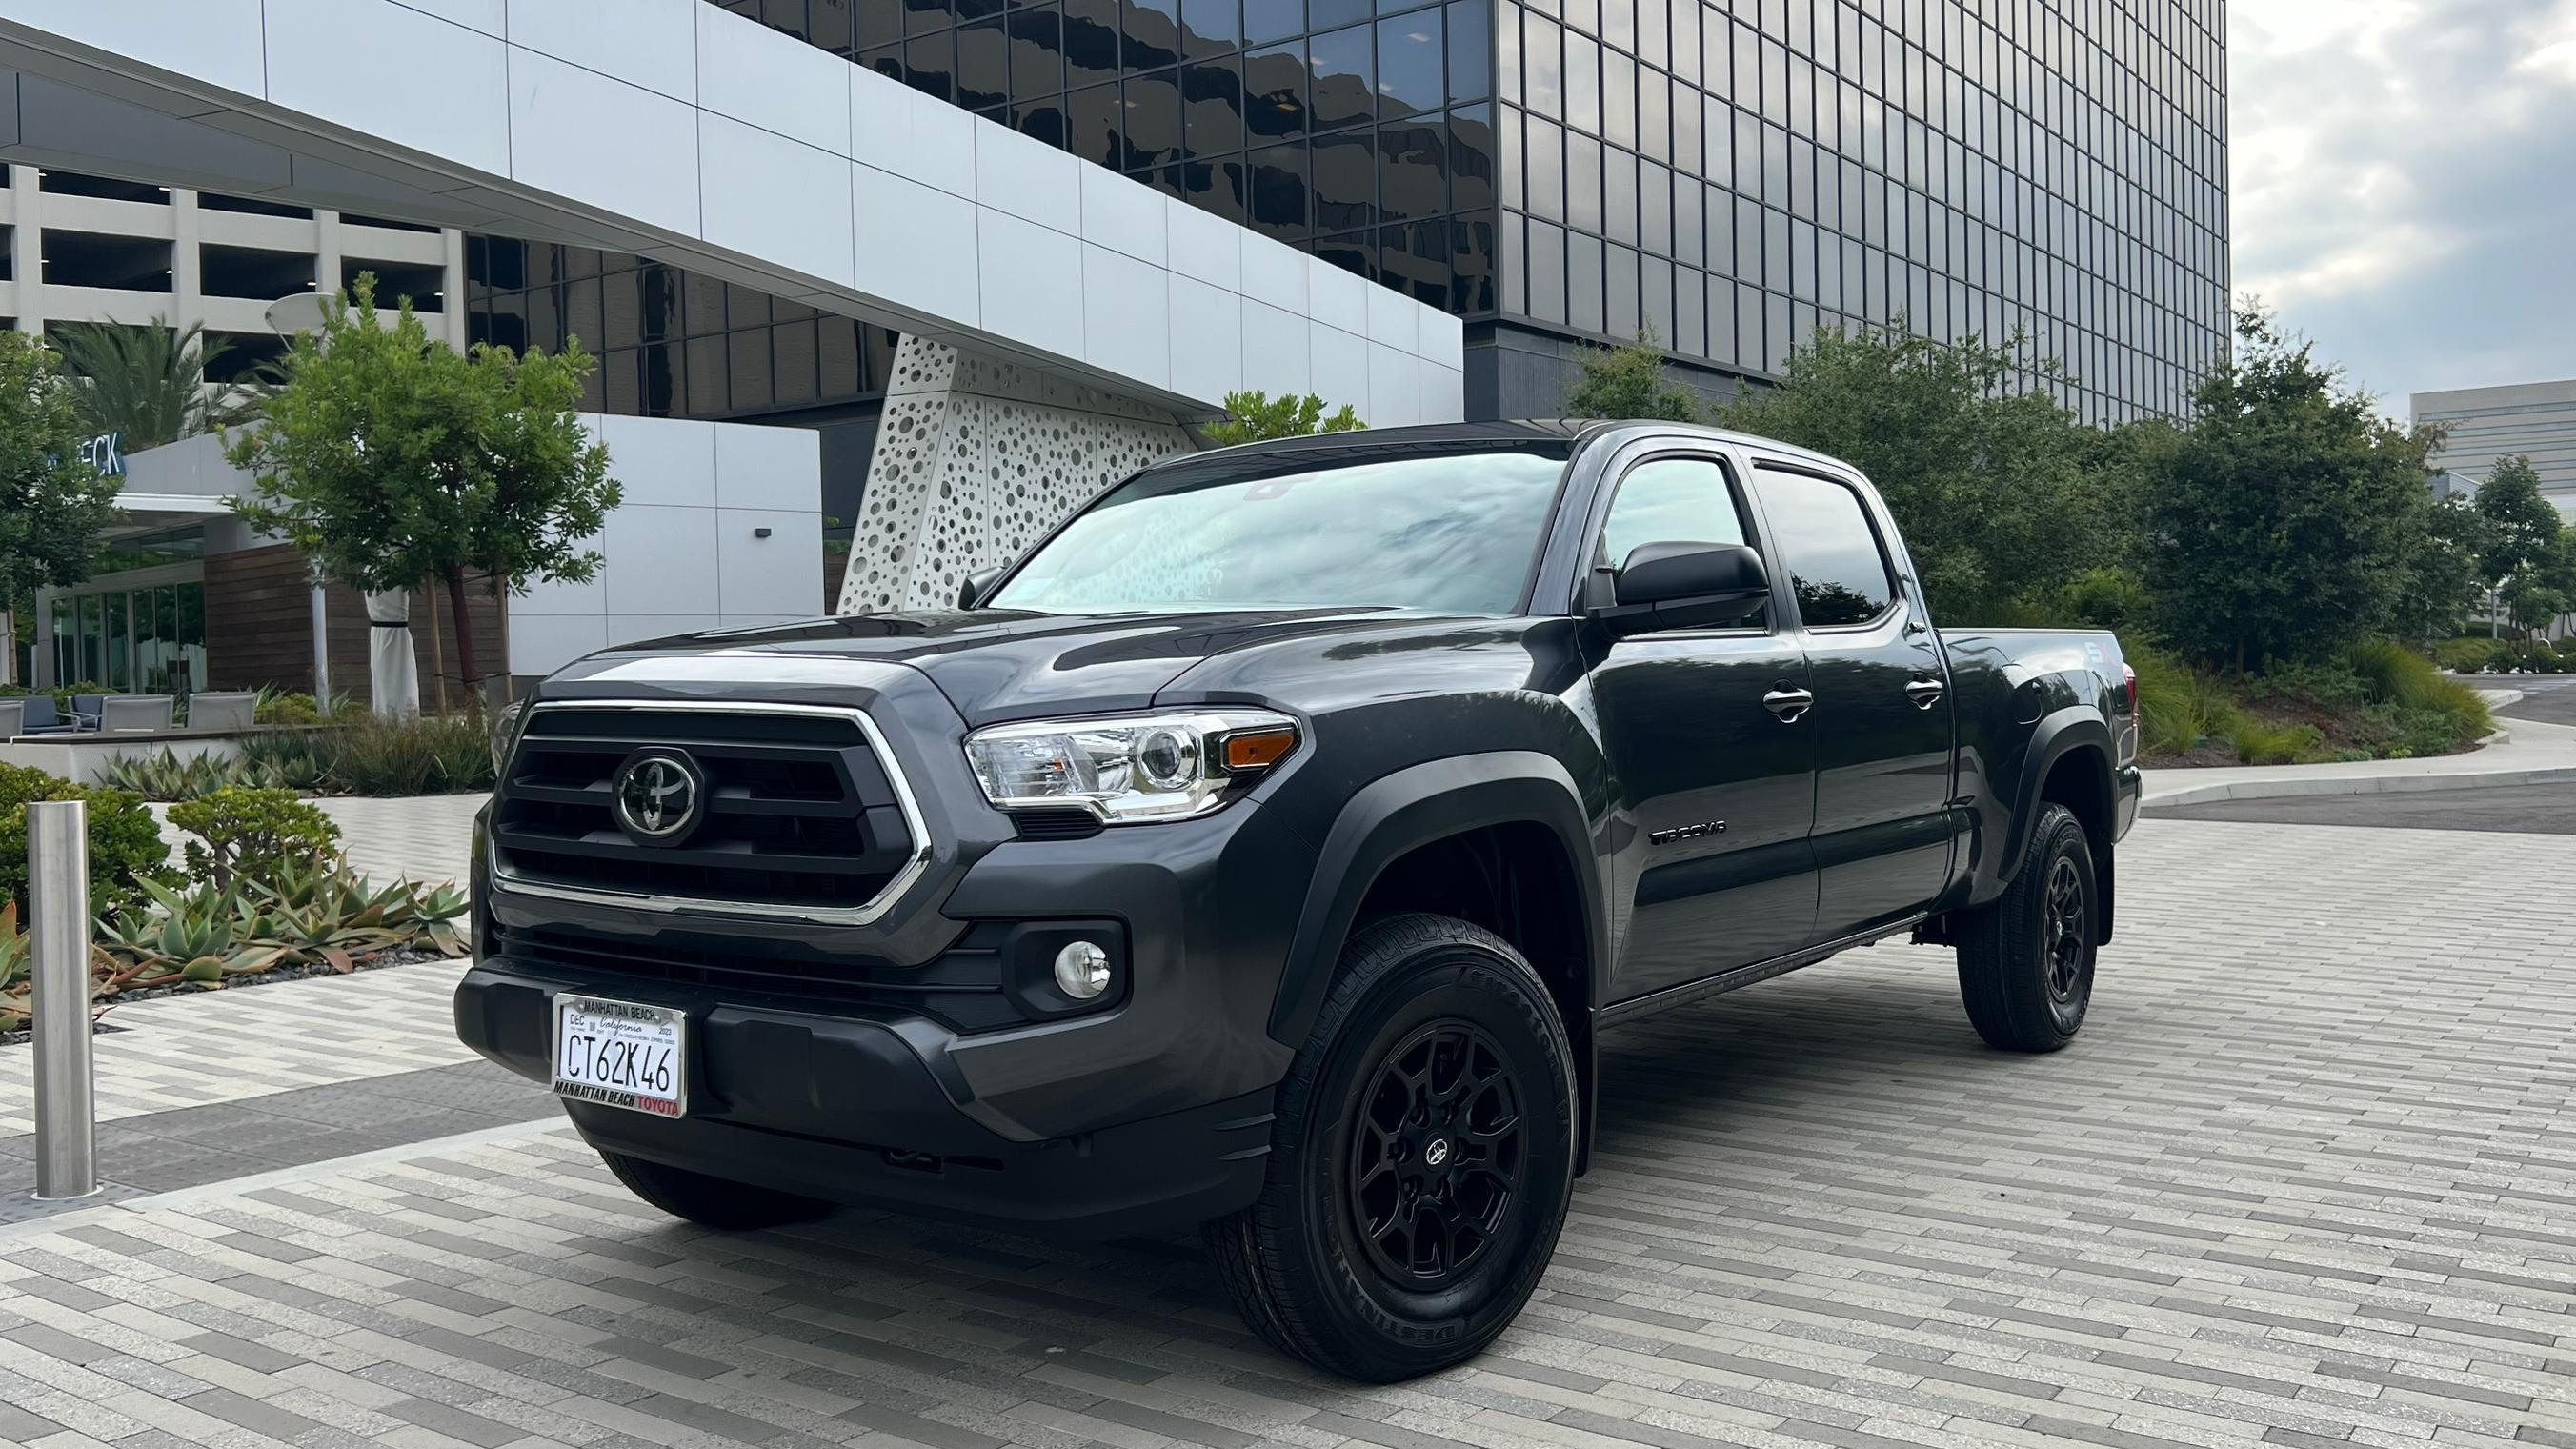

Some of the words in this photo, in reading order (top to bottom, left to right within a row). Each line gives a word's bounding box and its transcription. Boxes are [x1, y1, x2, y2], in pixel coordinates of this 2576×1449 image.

[570, 1015, 585, 1025] DEC
[584, 1000, 628, 1017] MANHATTAN
[632, 1008, 655, 1021] BEACH
[600, 1017, 642, 1036] California
[568, 1035, 671, 1092] CT62K46
[553, 1080, 606, 1100] MANHATTAN
[608, 1092, 635, 1107] BEACH
[637, 1096, 679, 1116] TOYOTA
